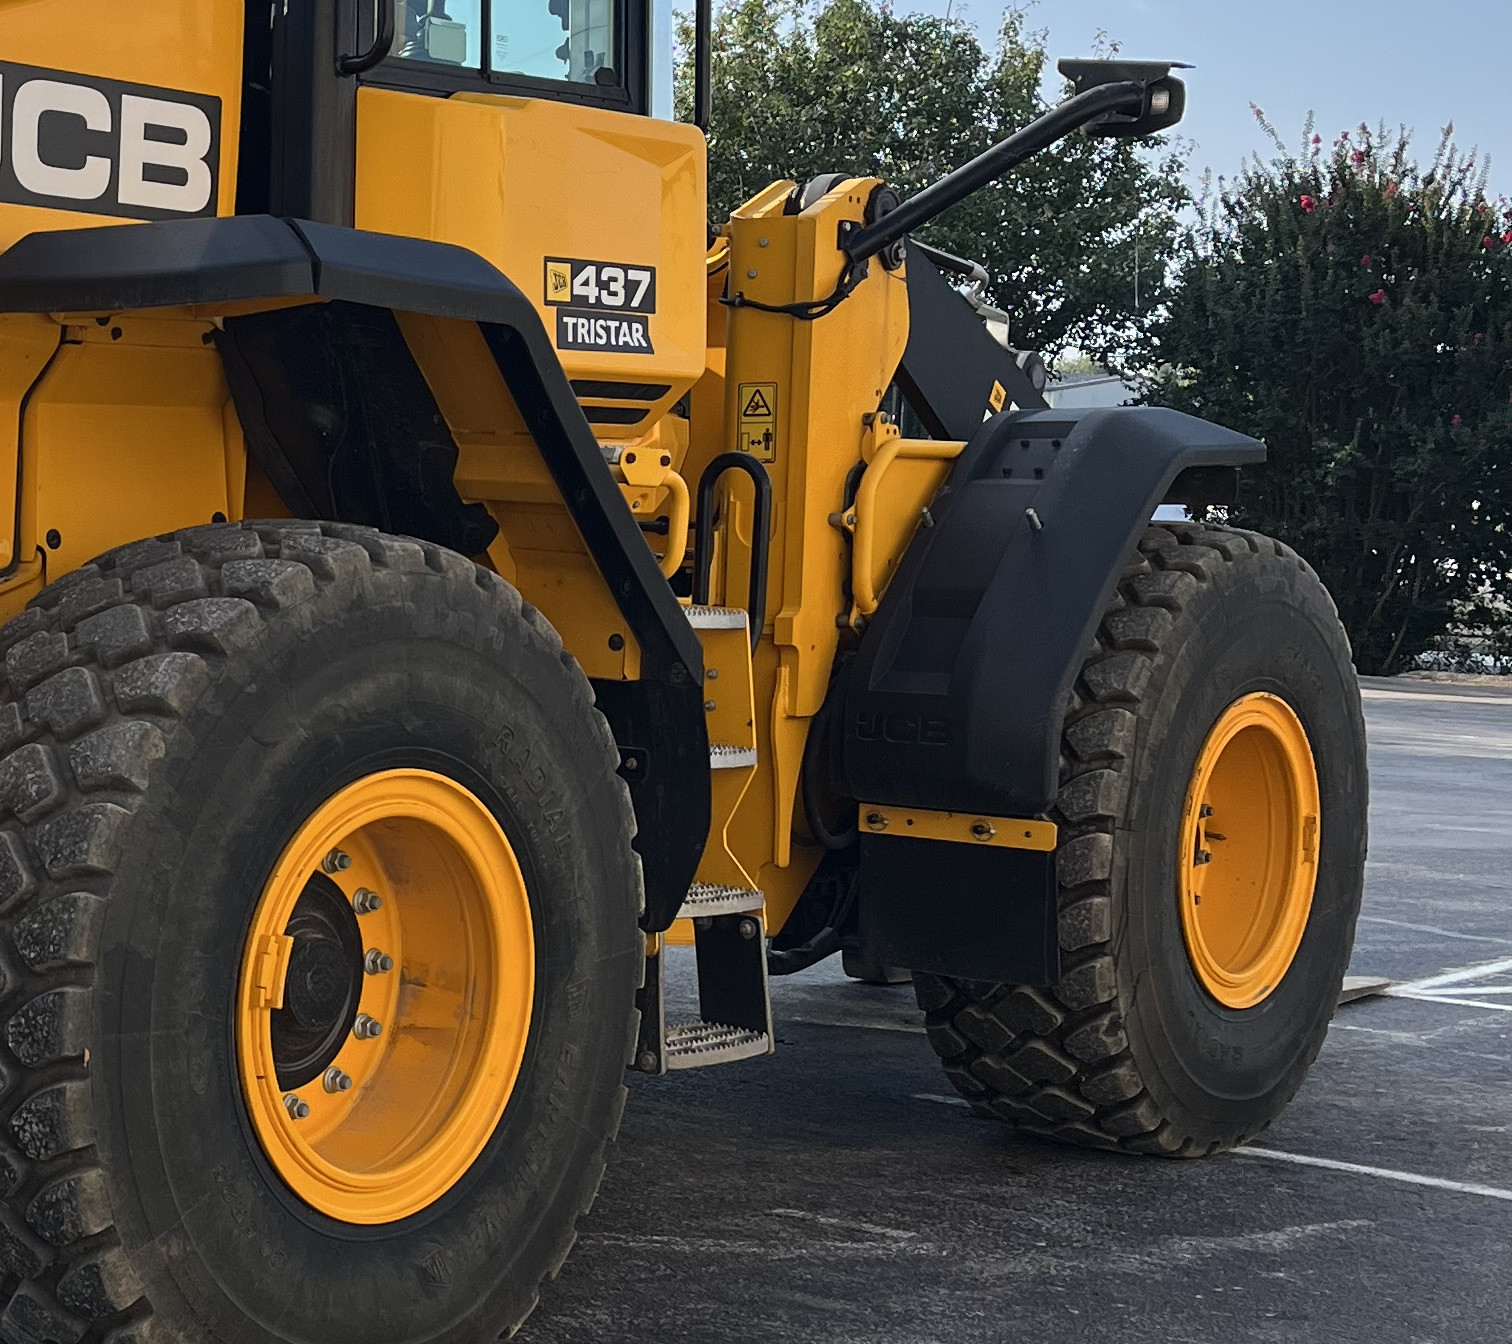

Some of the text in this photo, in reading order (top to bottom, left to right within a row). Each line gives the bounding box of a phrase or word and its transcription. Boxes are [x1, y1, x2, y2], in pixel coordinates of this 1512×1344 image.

[573, 265, 651, 307] 437
[562, 316, 648, 347] TRISTAR
[855, 712, 948, 746] JCB
[492, 724, 572, 857] RADIAL
